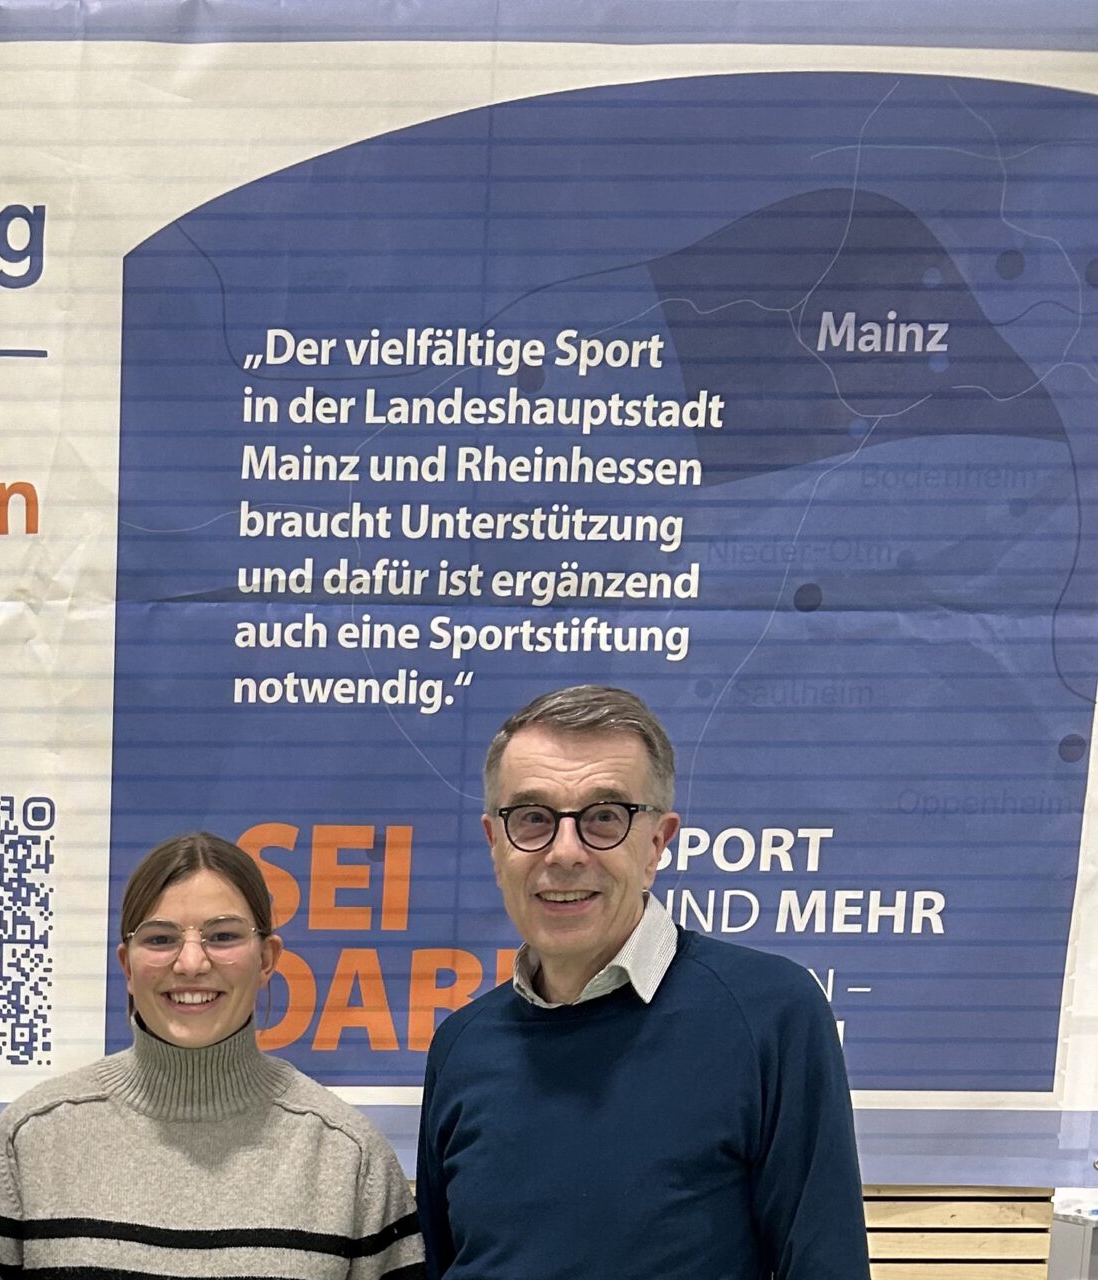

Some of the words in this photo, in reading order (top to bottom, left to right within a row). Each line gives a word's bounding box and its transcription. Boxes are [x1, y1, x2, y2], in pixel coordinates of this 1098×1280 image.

[344, 327, 546, 376] vielfältige
[554, 329, 665, 377] Sport
[816, 310, 949, 353] Mainz
[243, 386, 279, 423] in
[288, 386, 356, 424] der
[365, 386, 725, 435] Landeshauptstadt
[241, 444, 360, 483] Mainz
[369, 445, 447, 483] und
[457, 445, 702, 486] Rheinhessen
[239, 500, 392, 539] braucht
[401, 503, 684, 553] Unterstützung
[237, 557, 314, 594] und
[323, 558, 430, 596] dafür
[437, 559, 484, 598] ist
[491, 561, 700, 607] ergänzend
[234, 612, 328, 649] auch
[337, 613, 420, 651] eine
[428, 615, 690, 662] Sportstiftung
[235, 821, 414, 932] SEI
[775, 889, 946, 934] MEHR
